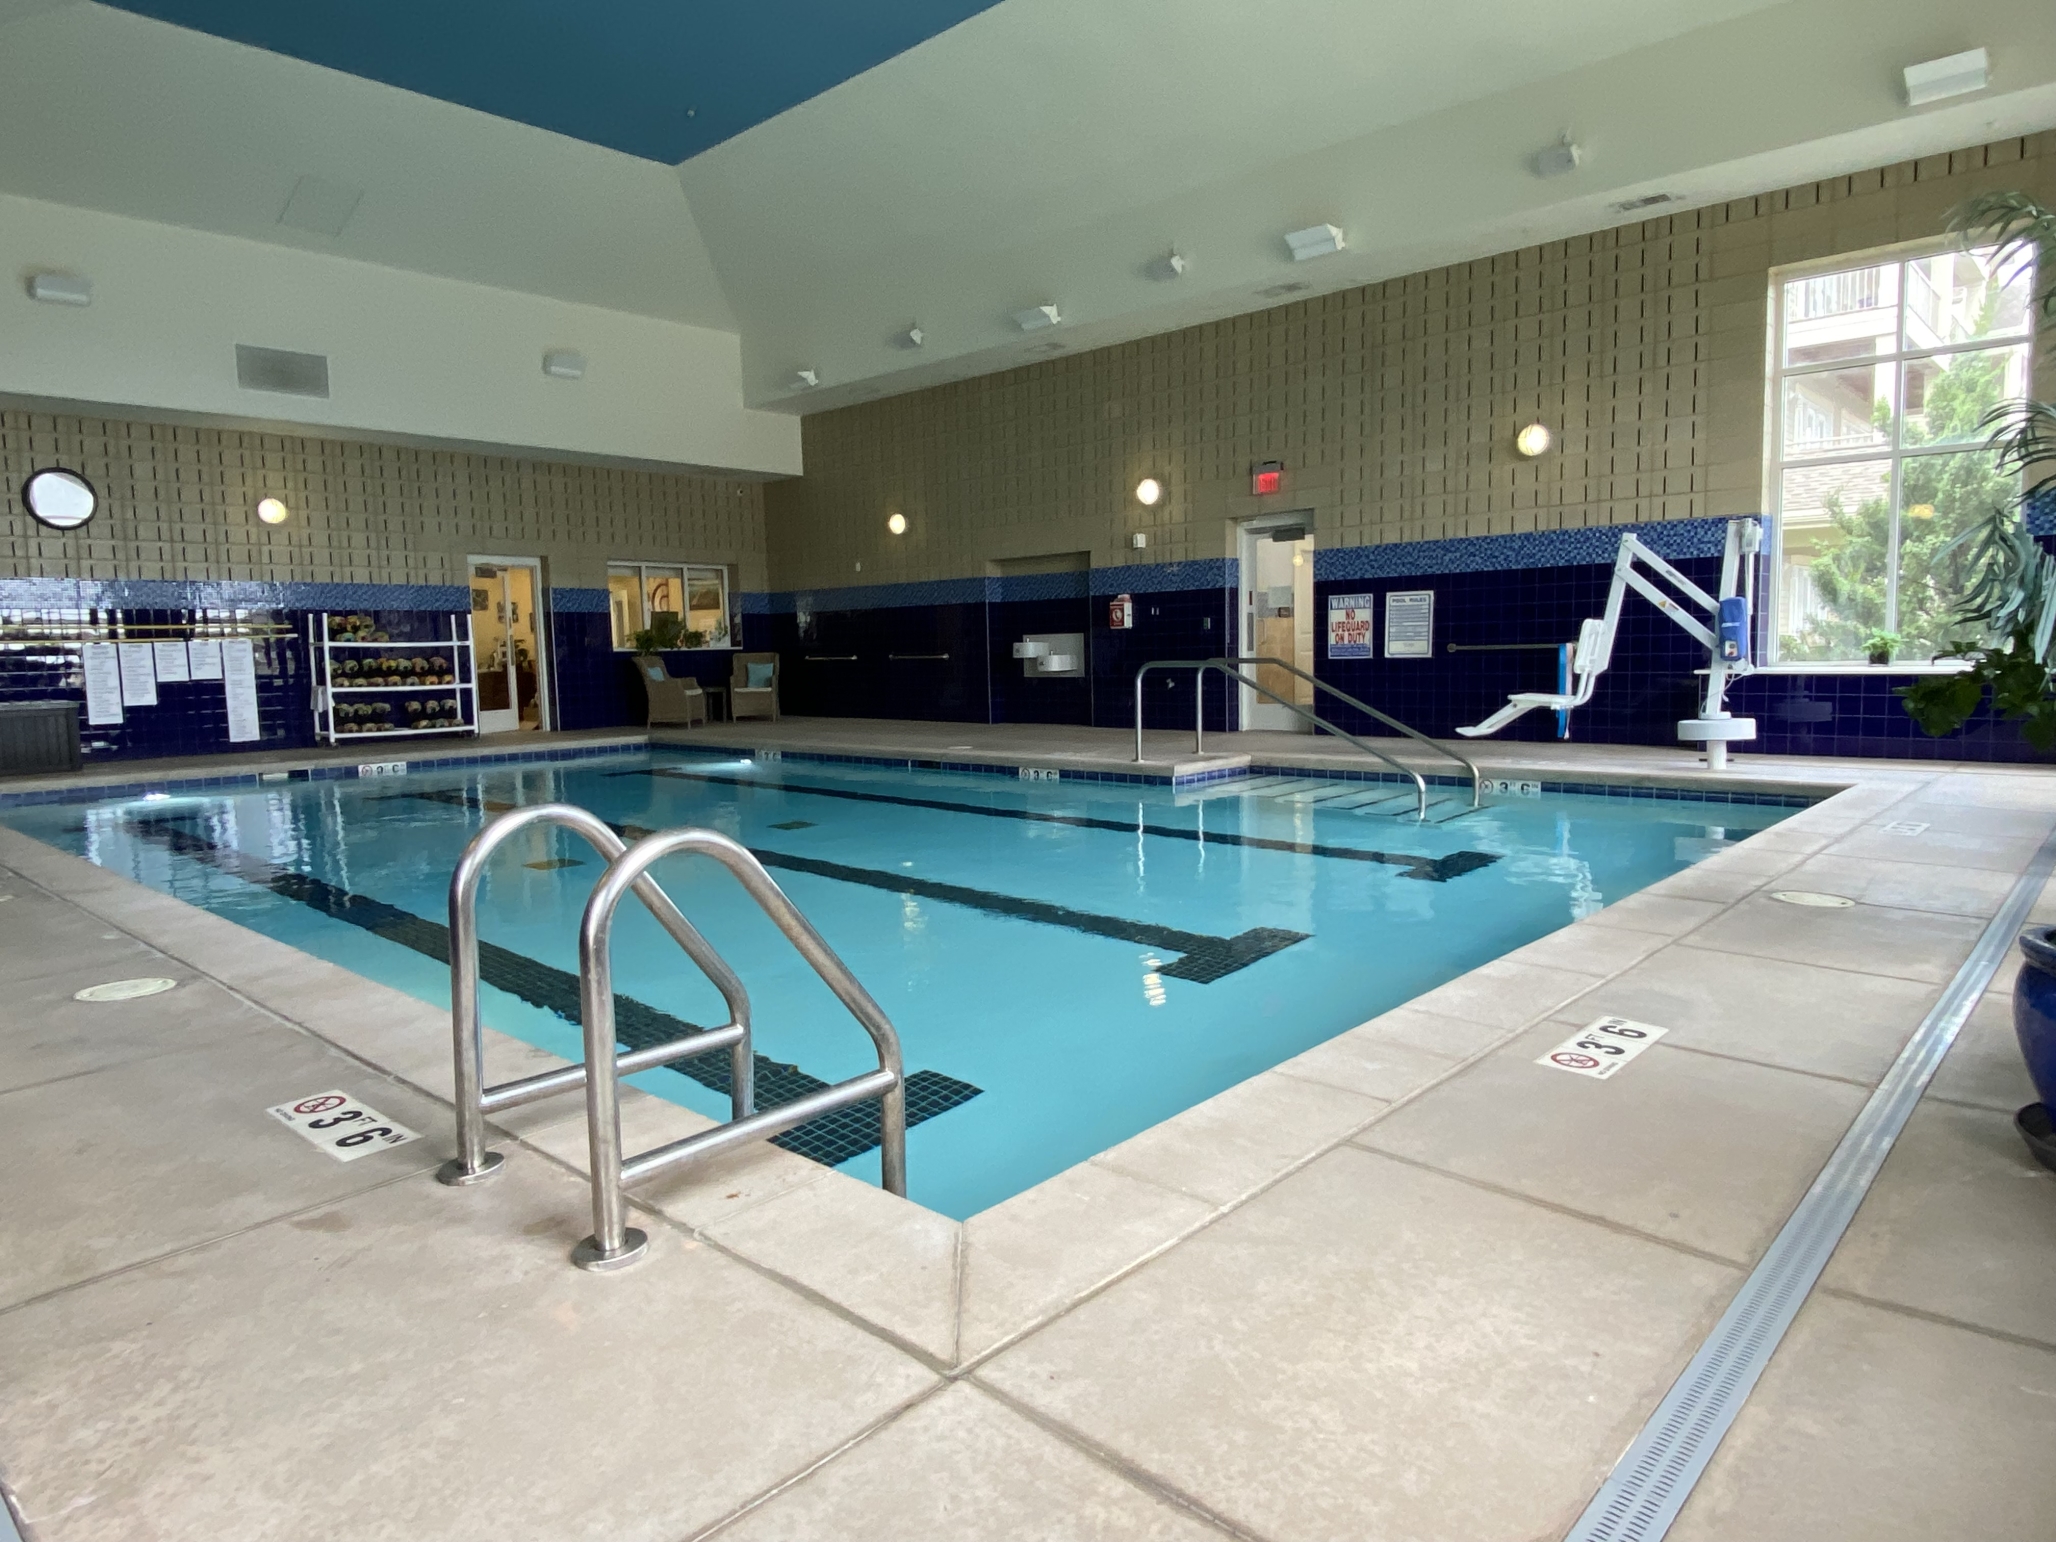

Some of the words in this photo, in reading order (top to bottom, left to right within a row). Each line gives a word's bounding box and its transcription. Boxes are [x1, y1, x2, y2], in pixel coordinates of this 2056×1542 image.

[1331, 596, 1370, 609] WARNING
[1345, 608, 1356, 621] NO
[1331, 620, 1370, 633] LIFEGUARD
[1335, 632, 1345, 644] ON
[1348, 631, 1366, 644] DUTY
[1598, 1025, 1648, 1039] 6
[1576, 1041, 1625, 1056] 3
[308, 1110, 363, 1129] 3
[335, 1127, 393, 1147] 6
